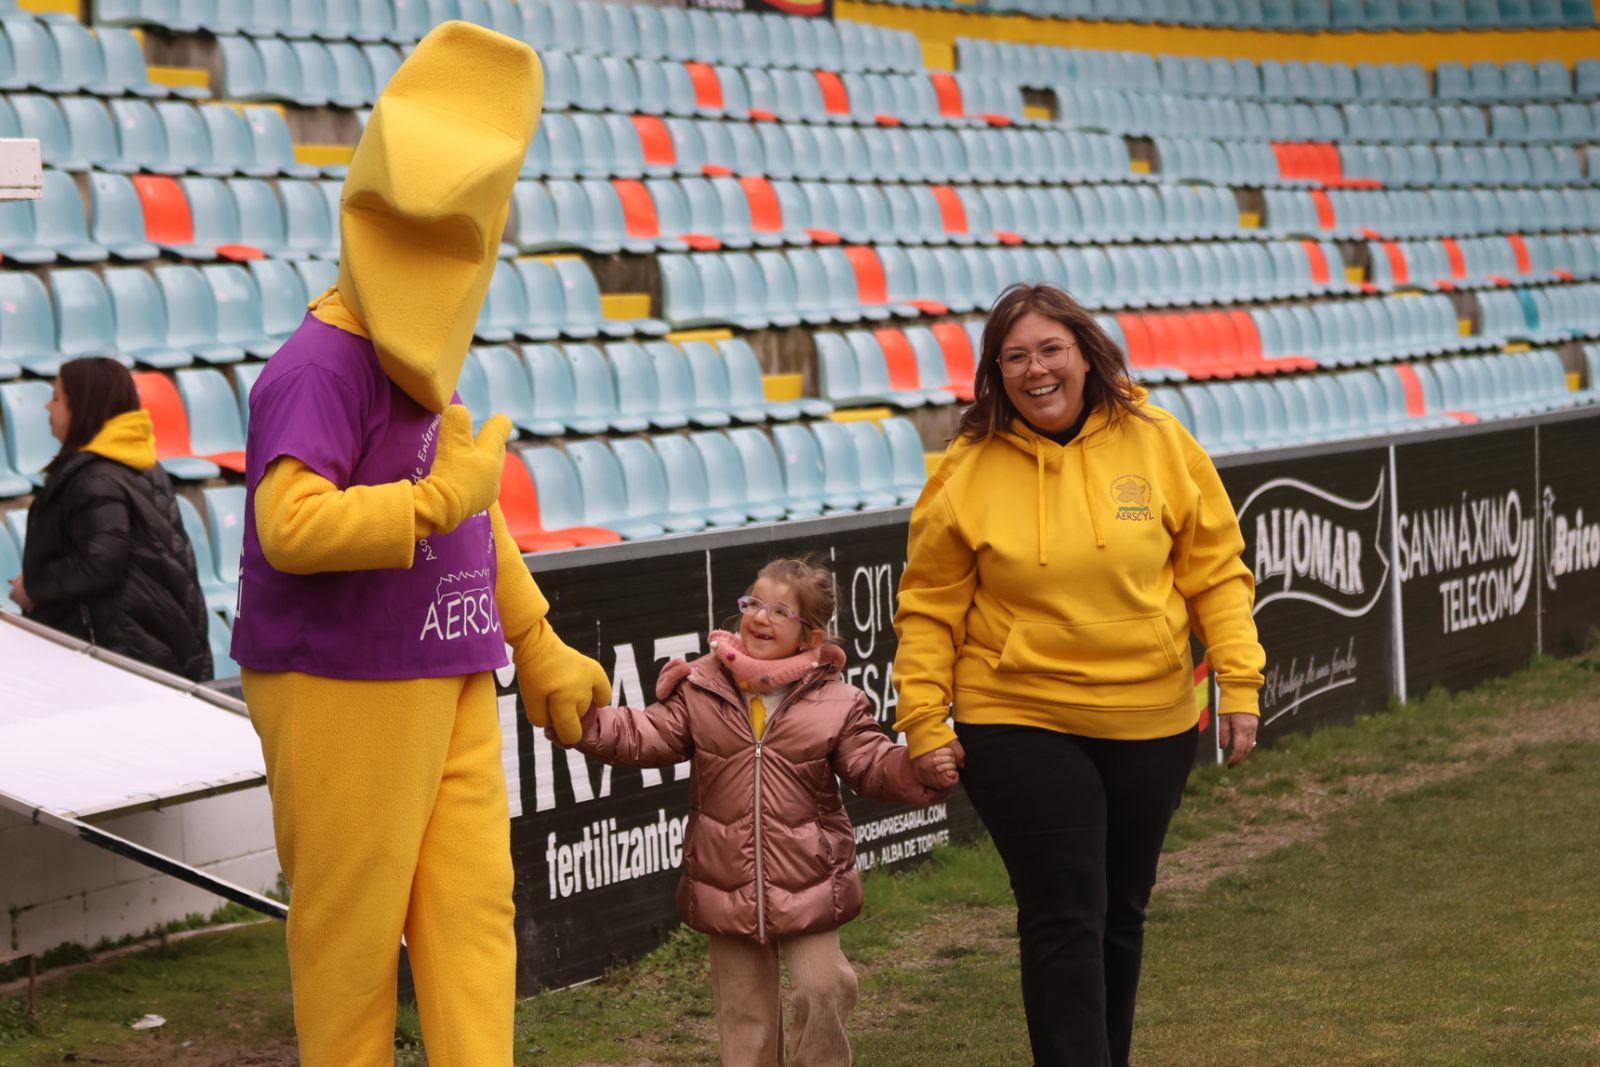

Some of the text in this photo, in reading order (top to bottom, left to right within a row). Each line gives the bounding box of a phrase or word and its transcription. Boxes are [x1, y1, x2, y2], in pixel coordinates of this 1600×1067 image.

[1115, 511, 1154, 522] AERSCYL
[1399, 488, 1521, 582] SANMÁXIMO
[1554, 508, 1600, 577] Brico
[1255, 508, 1364, 595] ALJOMAR
[1440, 567, 1513, 634] TELECOM
[854, 850, 876, 873] VILA
[881, 843, 903, 866] ALBA
[904, 838, 917, 859] DE
